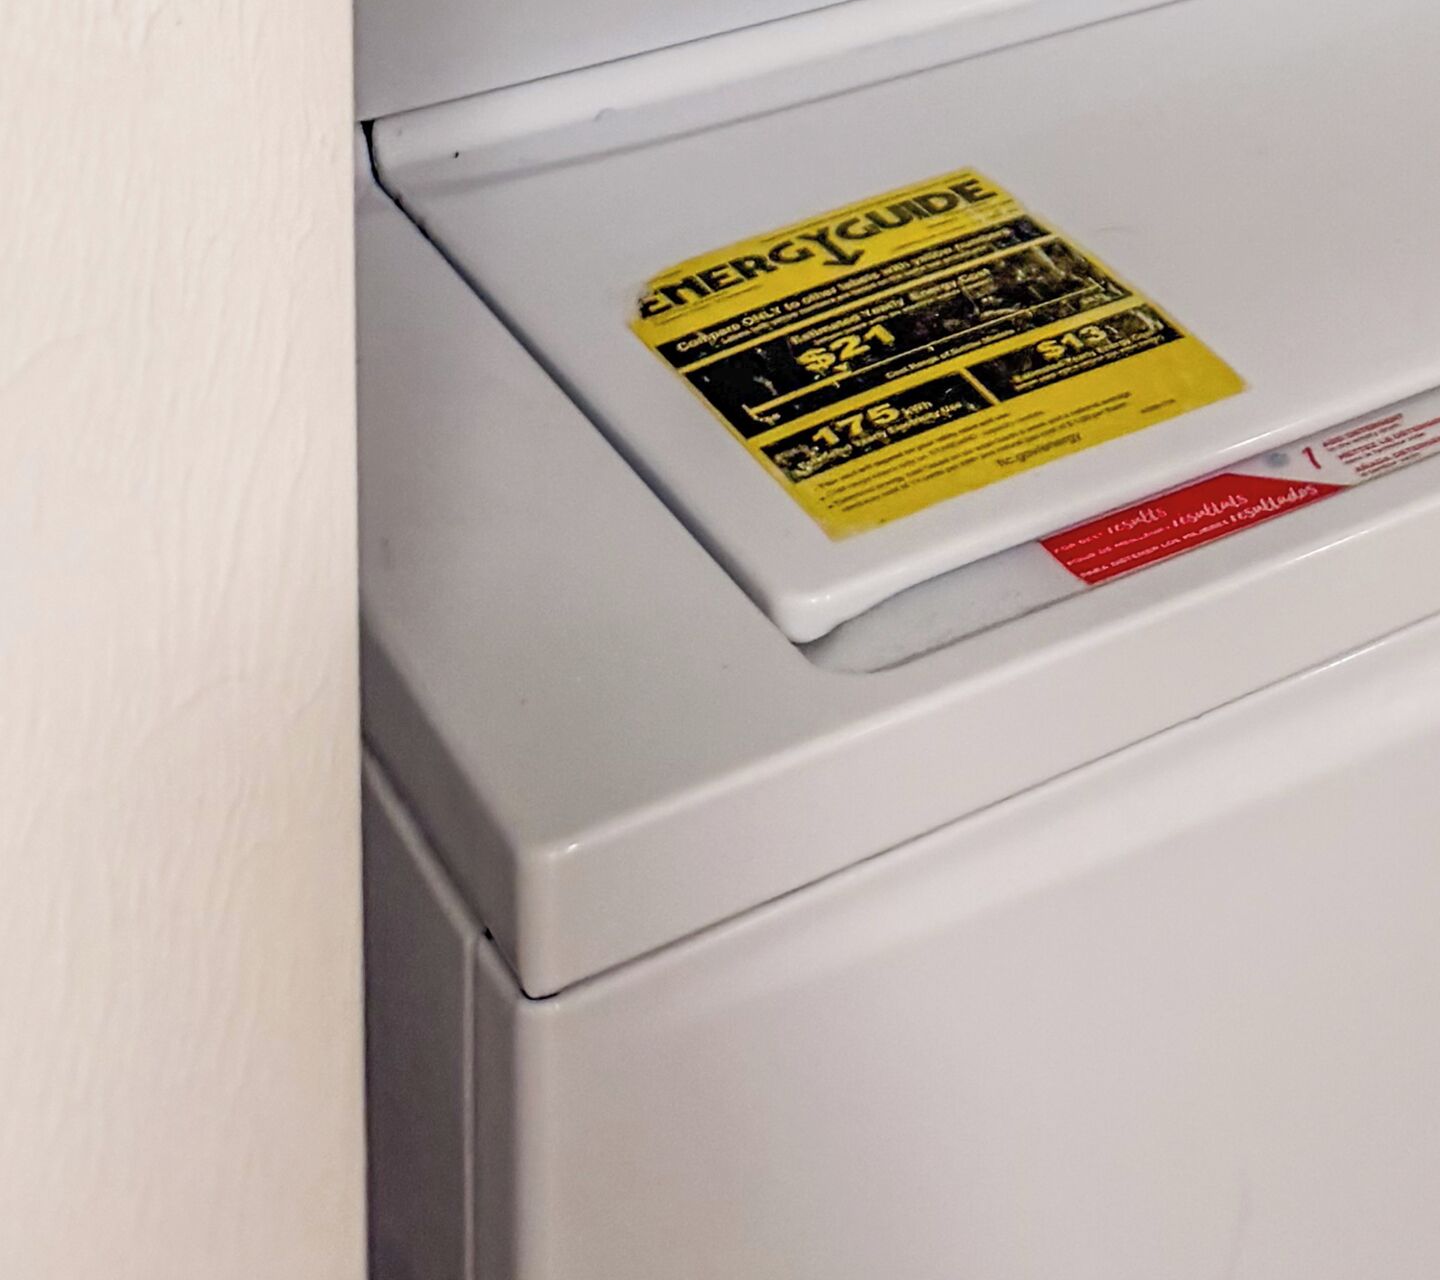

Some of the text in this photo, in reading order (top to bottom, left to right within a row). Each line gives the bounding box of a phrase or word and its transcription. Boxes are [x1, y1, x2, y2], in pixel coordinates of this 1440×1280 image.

[676, 322, 741, 351] Compare
[742, 306, 782, 326] ONLY
[784, 301, 800, 311] to
[802, 286, 837, 305] other
[790, 313, 861, 345] Estimated
[860, 297, 904, 318] Yearly
[796, 324, 895, 372] $21
[1036, 326, 1107, 361] $13
[812, 402, 900, 446] 175
[1302, 447, 1321, 469] 1
[1108, 507, 1167, 535] results
[1230, 483, 1318, 523] resultados
